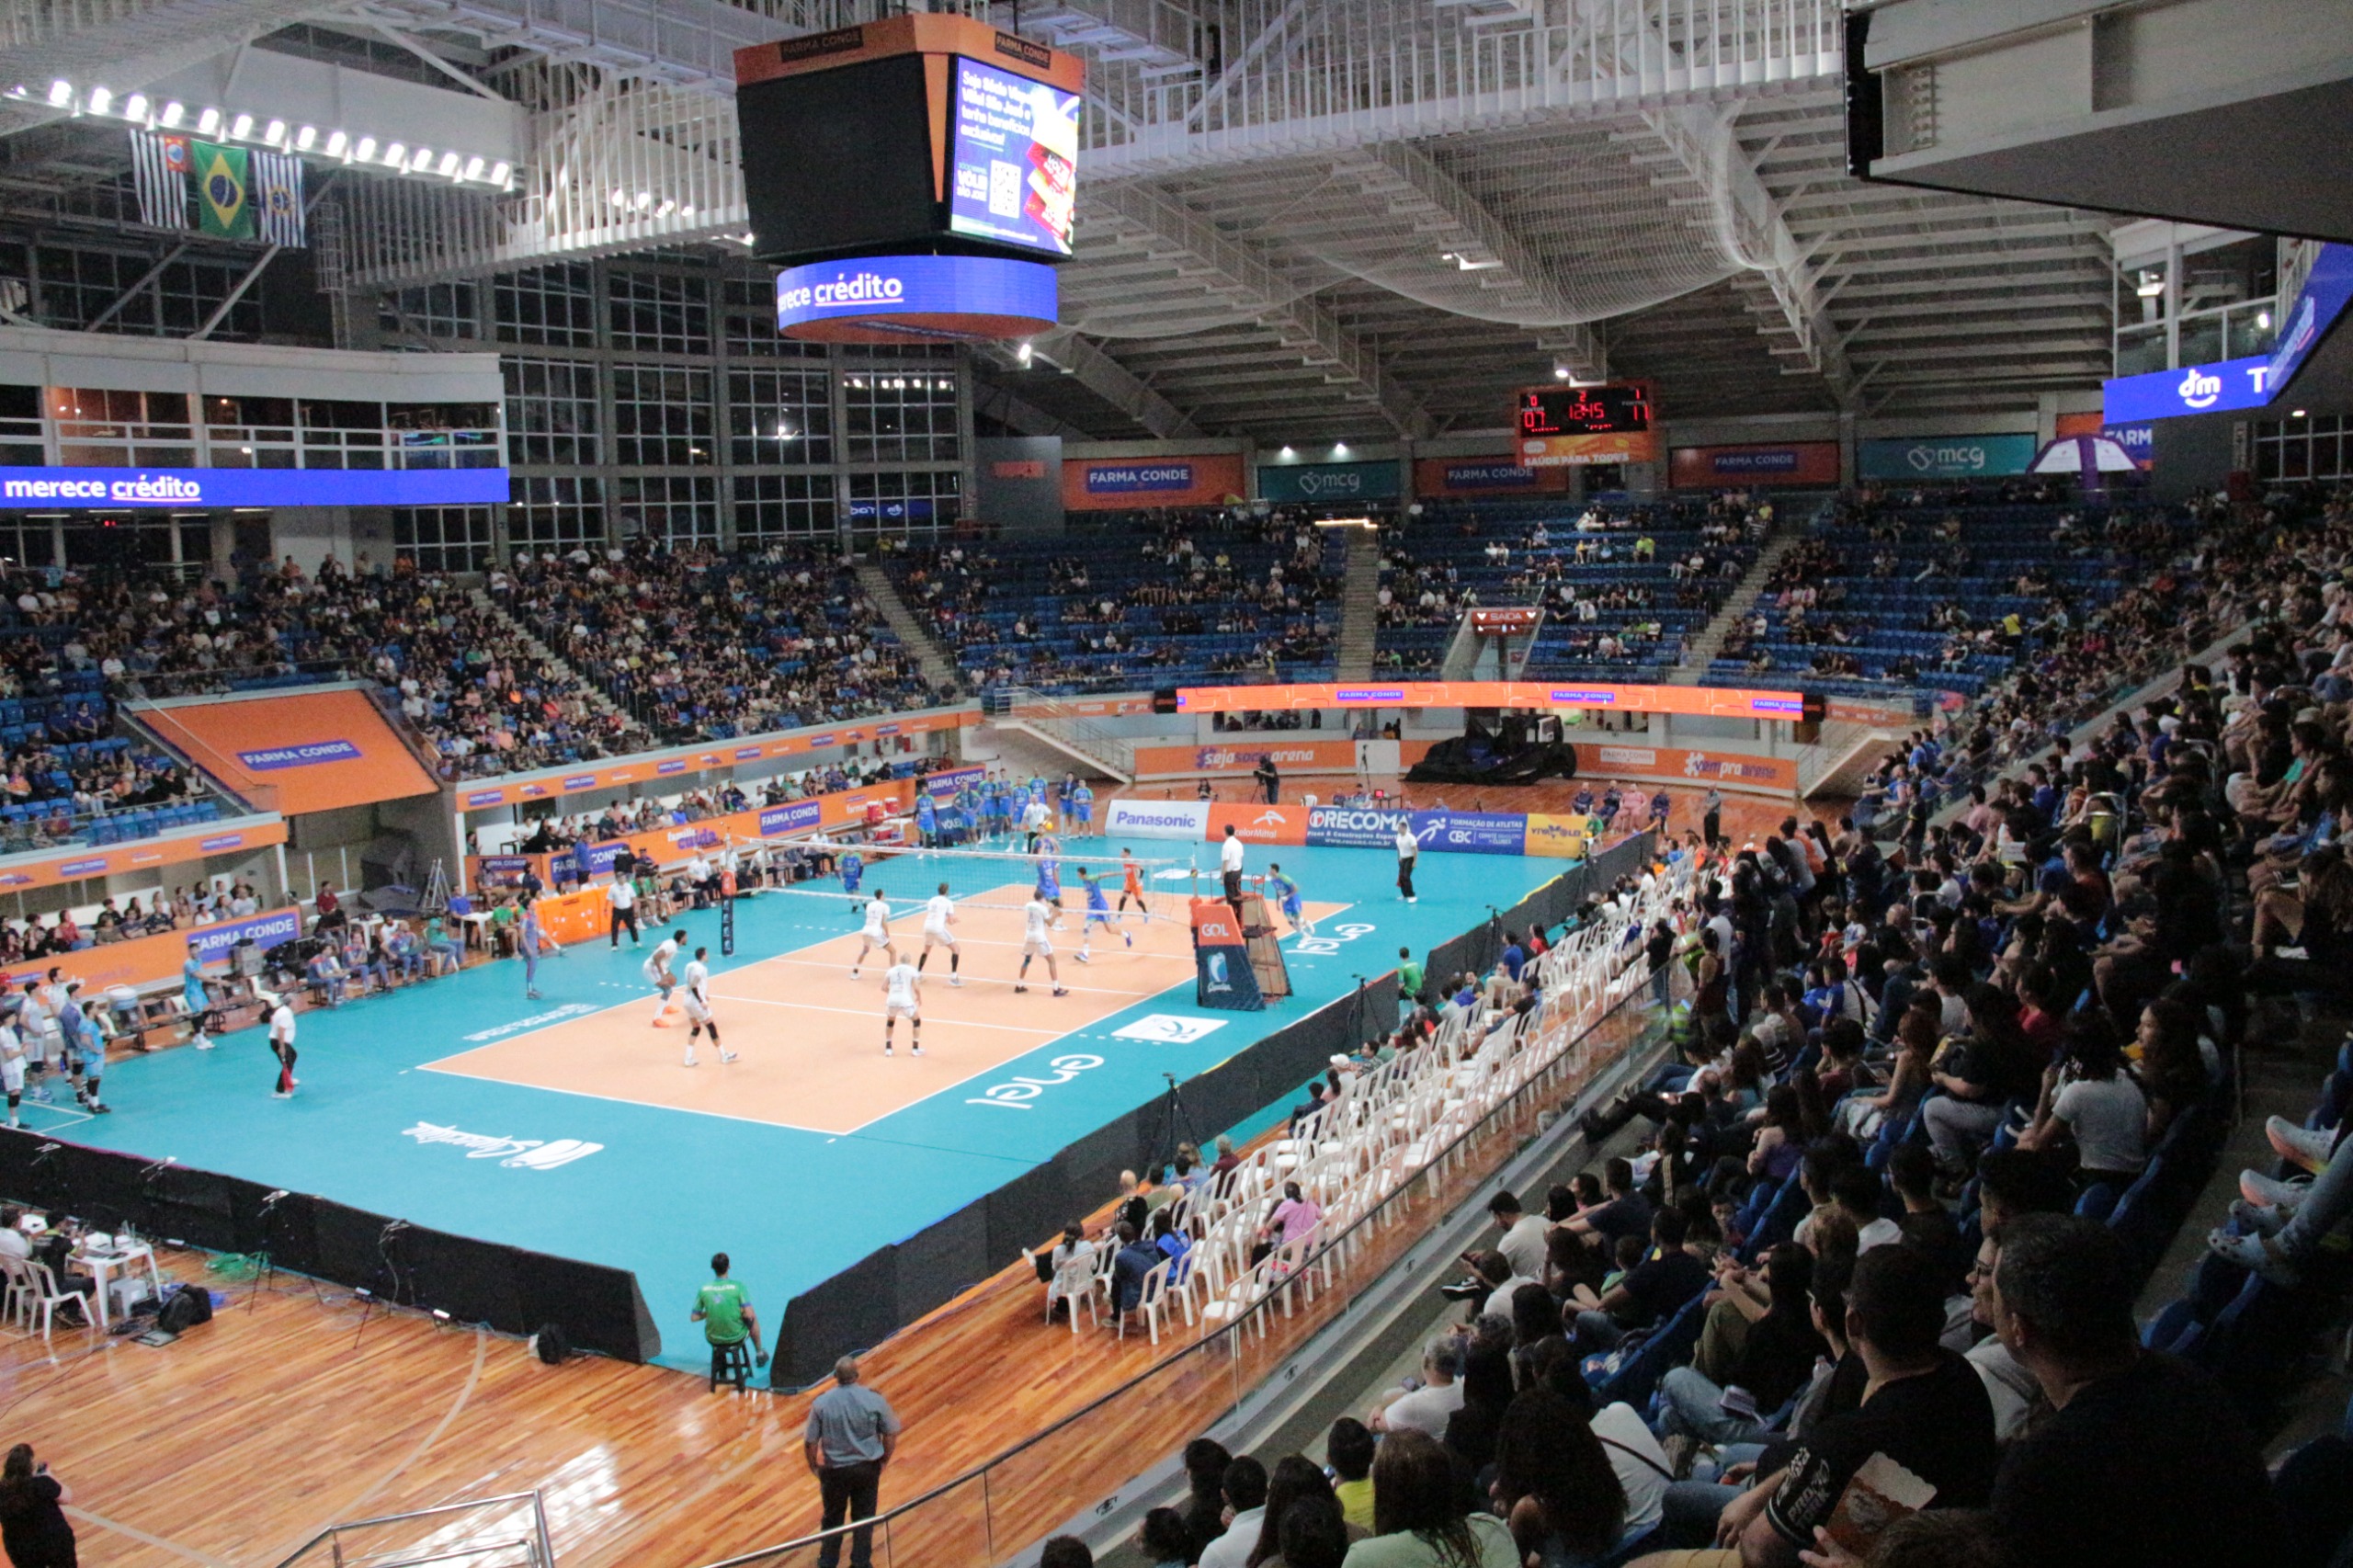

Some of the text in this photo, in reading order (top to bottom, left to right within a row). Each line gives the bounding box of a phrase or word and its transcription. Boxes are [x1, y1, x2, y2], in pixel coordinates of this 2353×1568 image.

[996, 33, 1022, 53] FARMA
[1023, 43, 1050, 62] CONDE
[814, 273, 904, 303] crédito
[2105, 428, 2153, 445] ARM
[1715, 454, 1794, 466] FARMA CONDE
[1938, 447, 1984, 469] mcg
[1089, 469, 1188, 483] FARMA CONDE
[1449, 467, 1534, 480] FARMA CONDE
[5, 475, 200, 498] merece crédito
[1322, 473, 1359, 493] mcg
[243, 743, 353, 764] FARMA CONDE
[928, 778, 954, 790] FARMA
[762, 805, 819, 826] FARMA CONDE
[1117, 812, 1196, 827] Panasonic
[1449, 818, 1523, 828] FORMAÇÃO DE ATLETAS
[940, 817, 961, 830] VÔLE
[1234, 828, 1277, 838] celorMittal
[1449, 830, 1472, 844] CBC
[244, 918, 295, 938] CONDE
[1201, 923, 1229, 937] GOL
